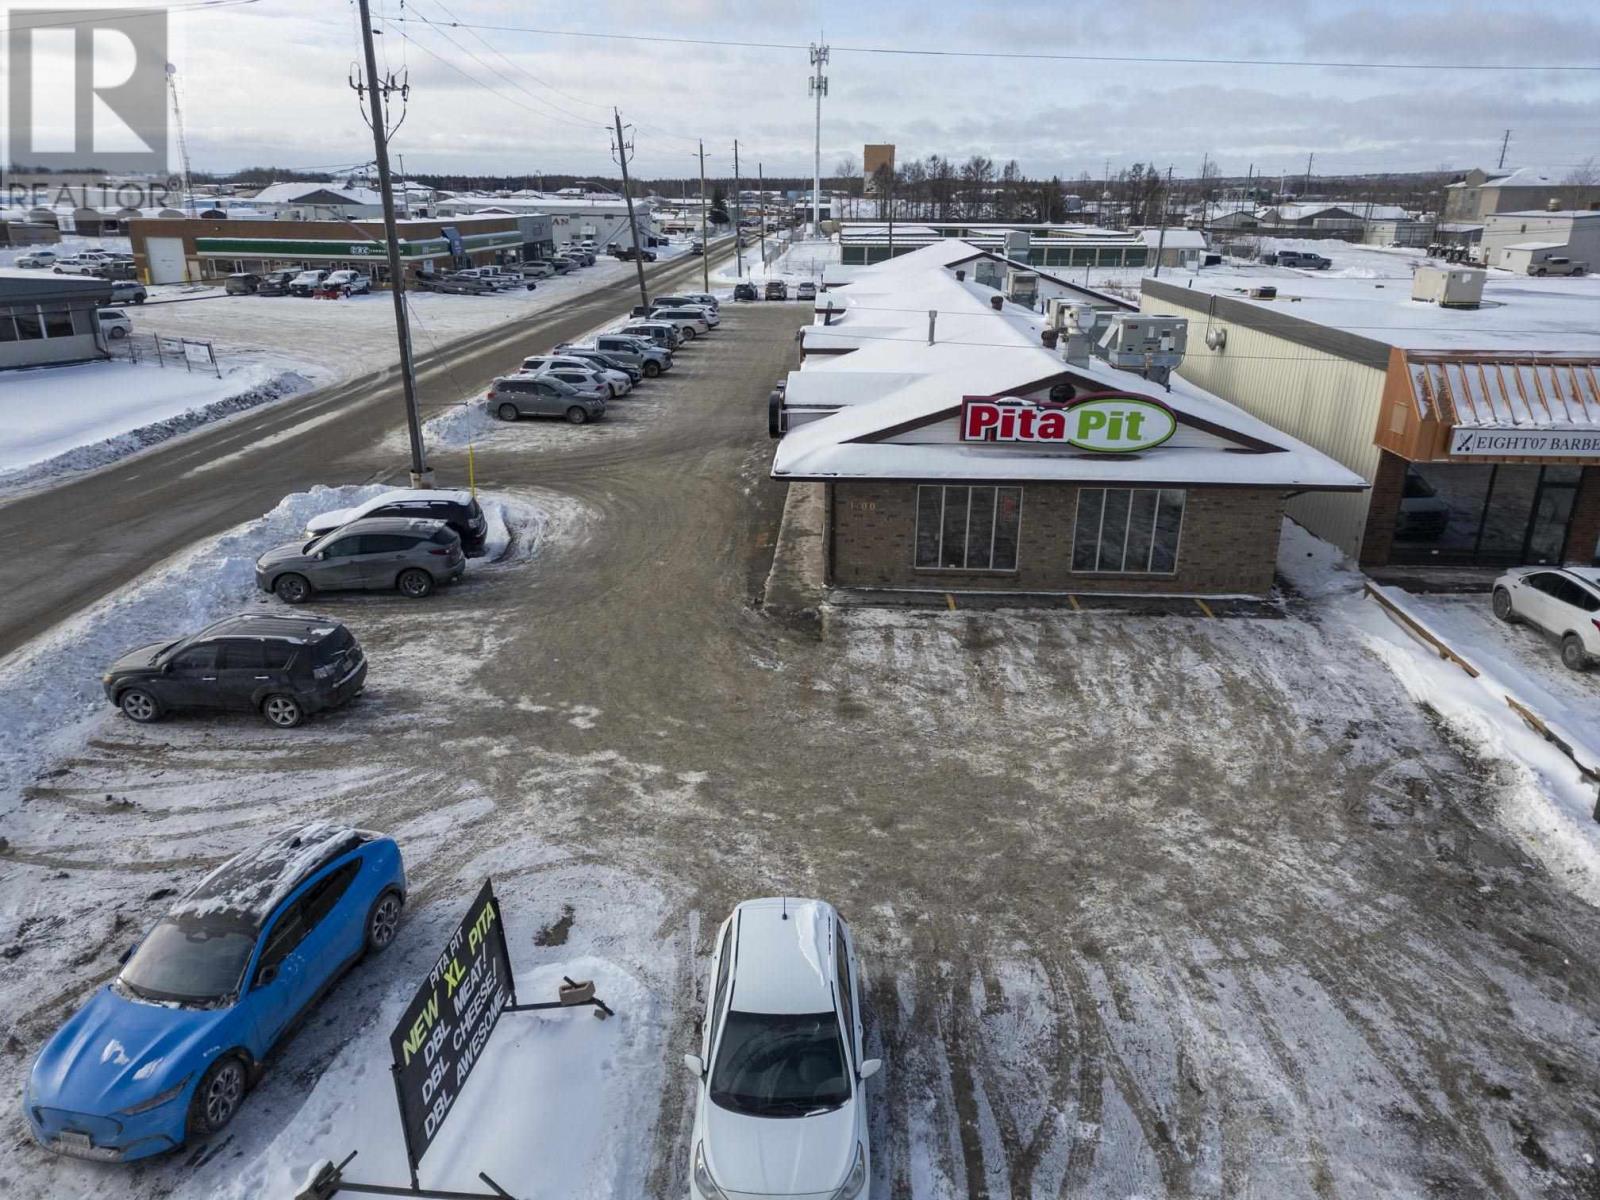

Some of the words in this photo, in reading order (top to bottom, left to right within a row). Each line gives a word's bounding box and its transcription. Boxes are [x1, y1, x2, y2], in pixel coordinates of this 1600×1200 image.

[969, 405, 1066, 440] Pita
[1077, 410, 1146, 441] Pit
[1476, 436, 1548, 450] EIGHT07
[402, 990, 439, 1066] NEW
[443, 957, 466, 998] XL
[468, 901, 496, 956] PITA
[423, 1018, 451, 1067] DBL
[454, 943, 487, 1017] MEAT!
[429, 953, 450, 990] PITA
[449, 926, 464, 957] PIT
[421, 1059, 450, 1106] DBL
[453, 958, 497, 1051] CHEESE!
[423, 1091, 453, 1141] DBL
[456, 984, 505, 1087] AWESOME
